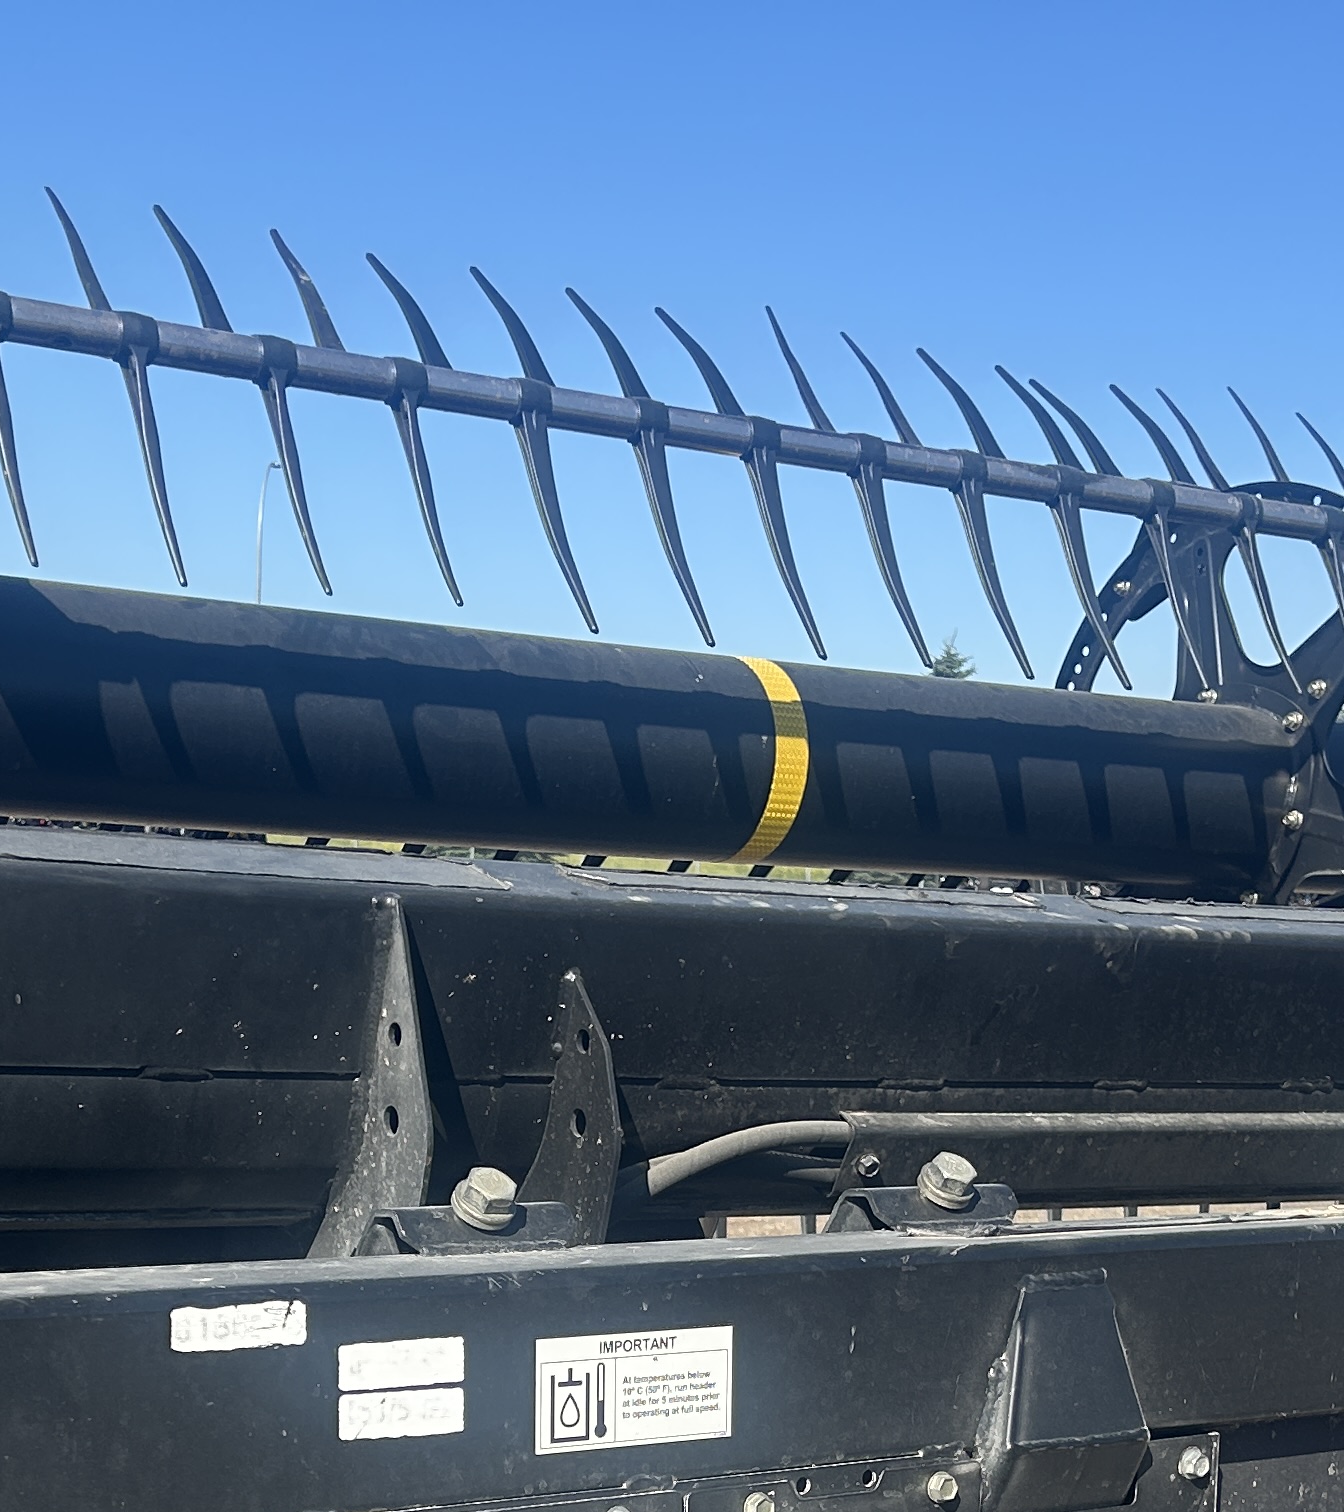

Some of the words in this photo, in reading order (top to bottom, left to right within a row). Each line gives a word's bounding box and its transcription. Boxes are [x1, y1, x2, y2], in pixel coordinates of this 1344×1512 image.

[600, 1336, 677, 1354] IMPORTANT
[634, 1373, 685, 1384] temperatures
[690, 1382, 716, 1390] header
[632, 1398, 646, 1406] idle
[669, 1394, 699, 1403] minutes
[702, 1392, 720, 1402] prior
[633, 1408, 669, 1419] operating
[695, 1404, 720, 1414] speed.
